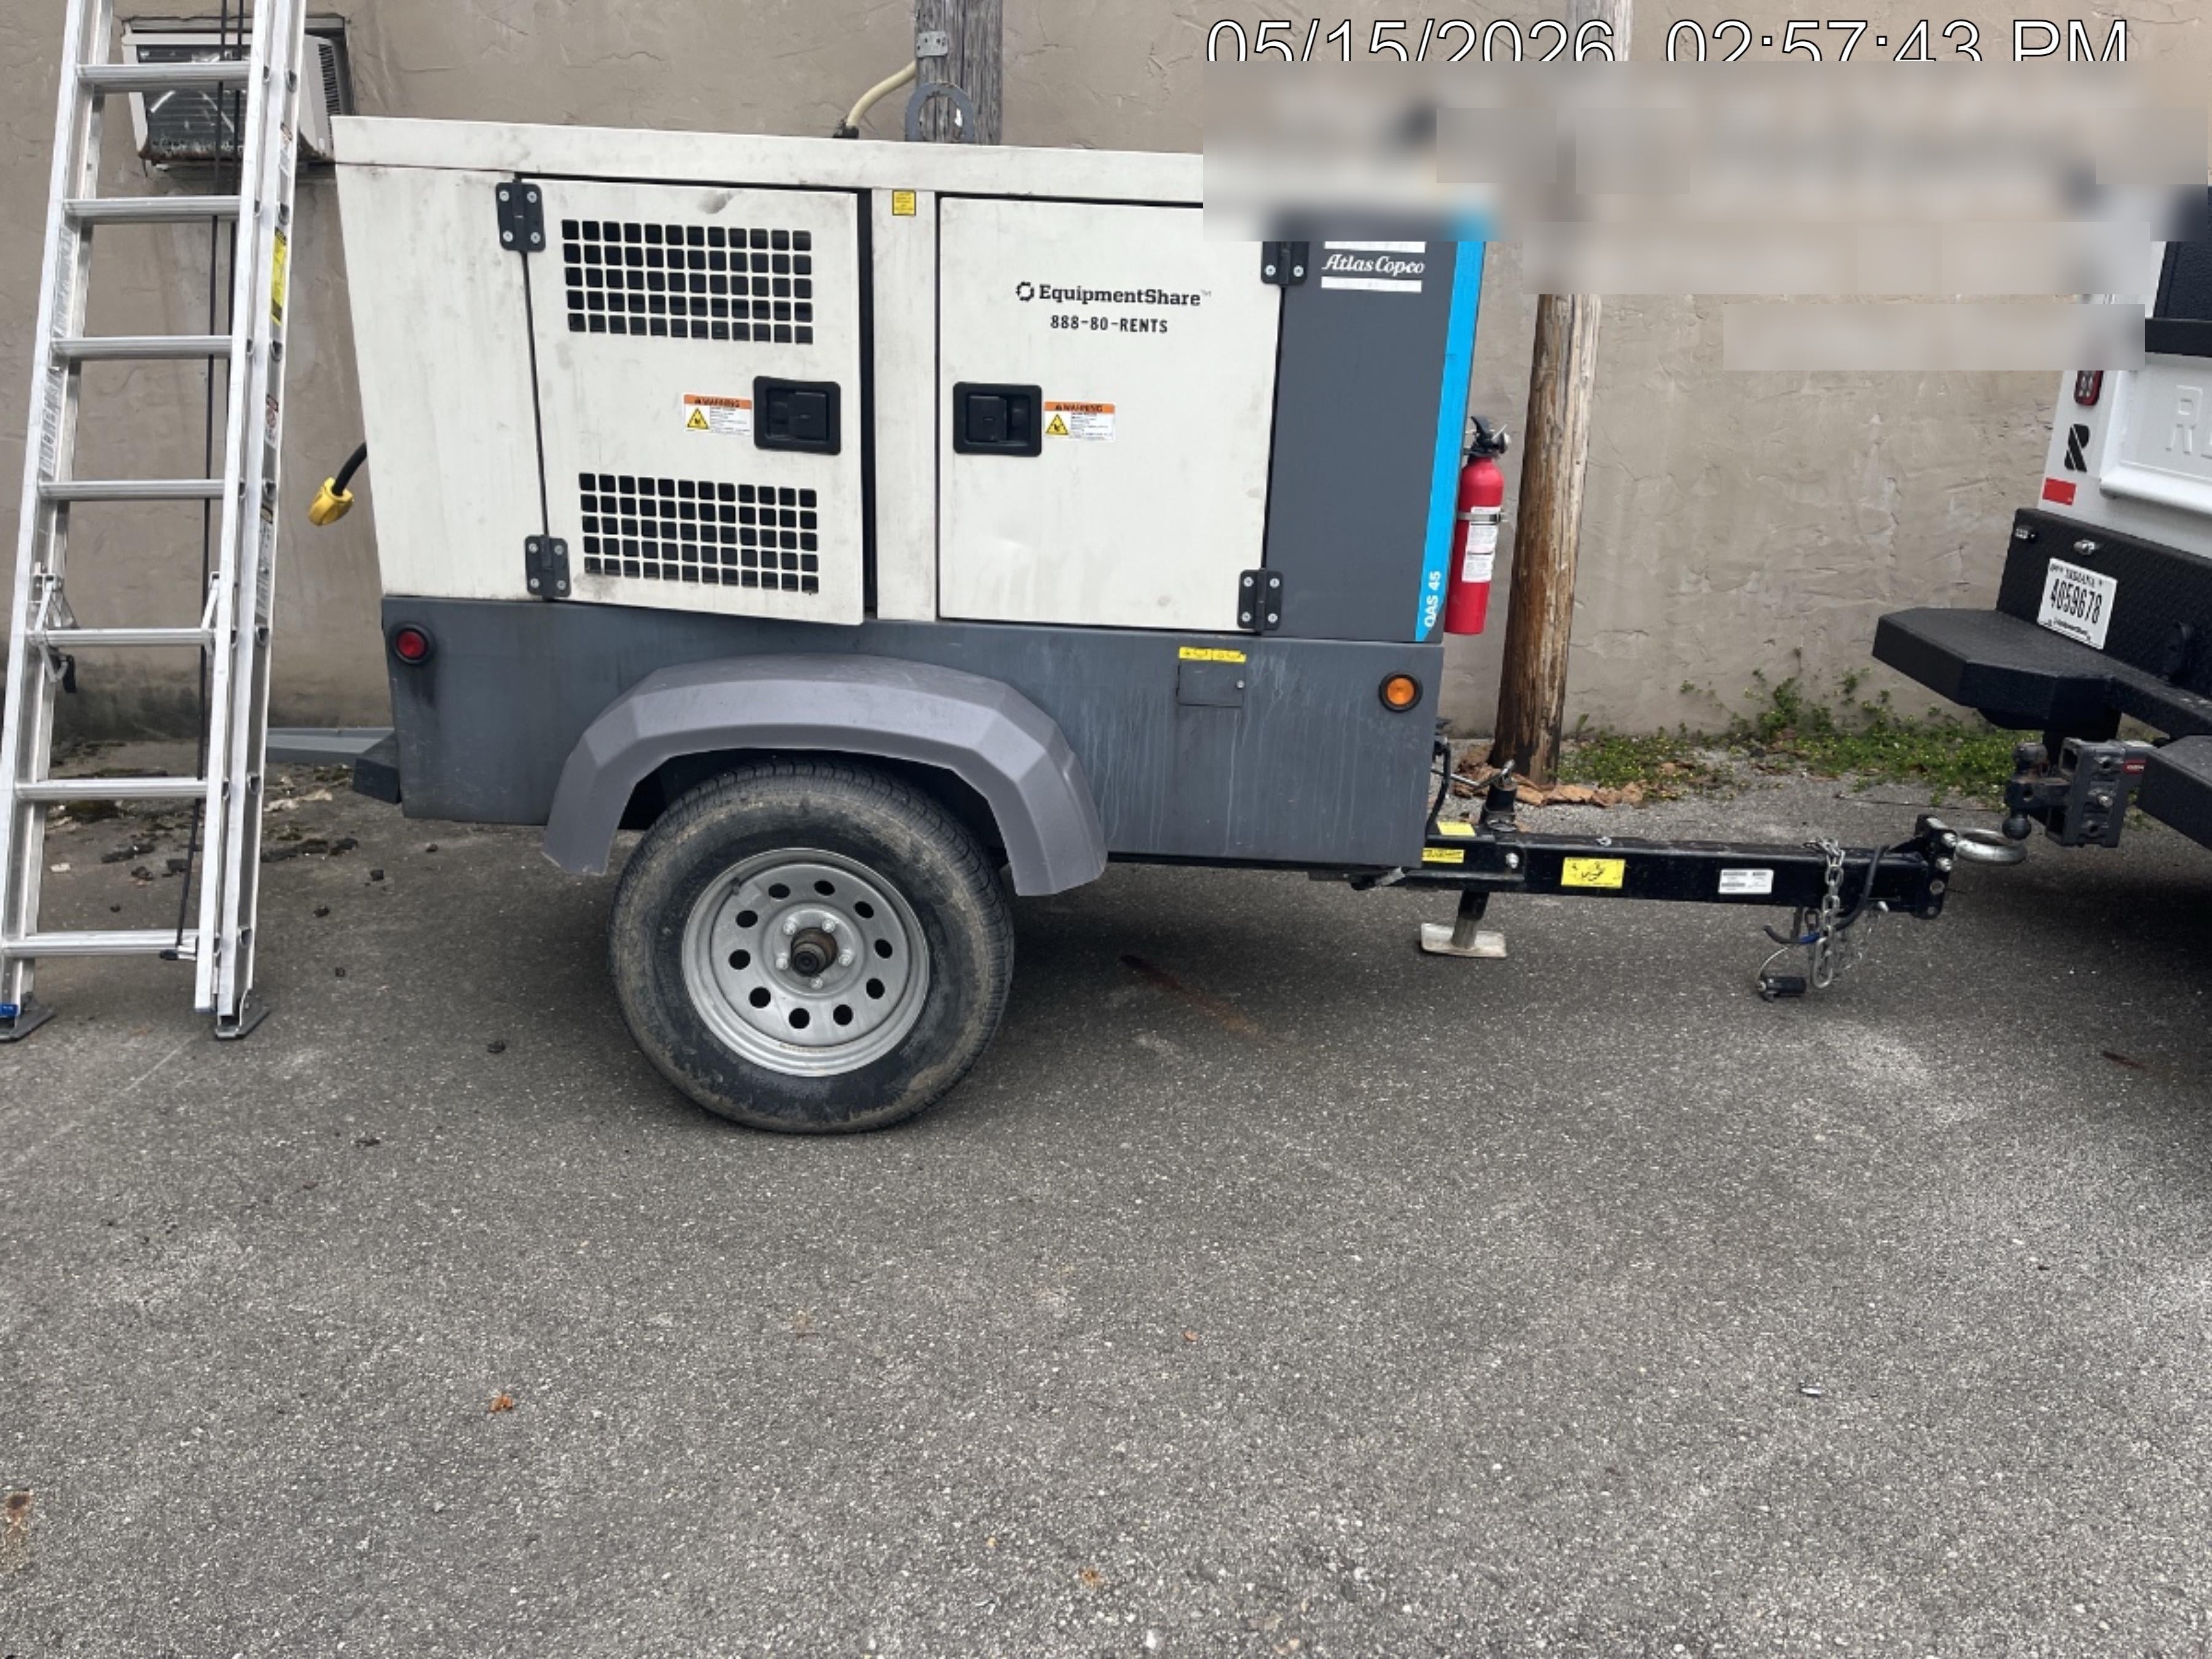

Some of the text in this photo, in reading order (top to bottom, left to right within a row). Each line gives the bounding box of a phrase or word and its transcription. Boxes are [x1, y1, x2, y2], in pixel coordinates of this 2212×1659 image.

[1322, 254, 1426, 277] Atlas Copco
[1039, 284, 1201, 306] EquipmentShare
[1050, 308, 1168, 334] 888-80-RENTS
[1428, 570, 1441, 591] 45
